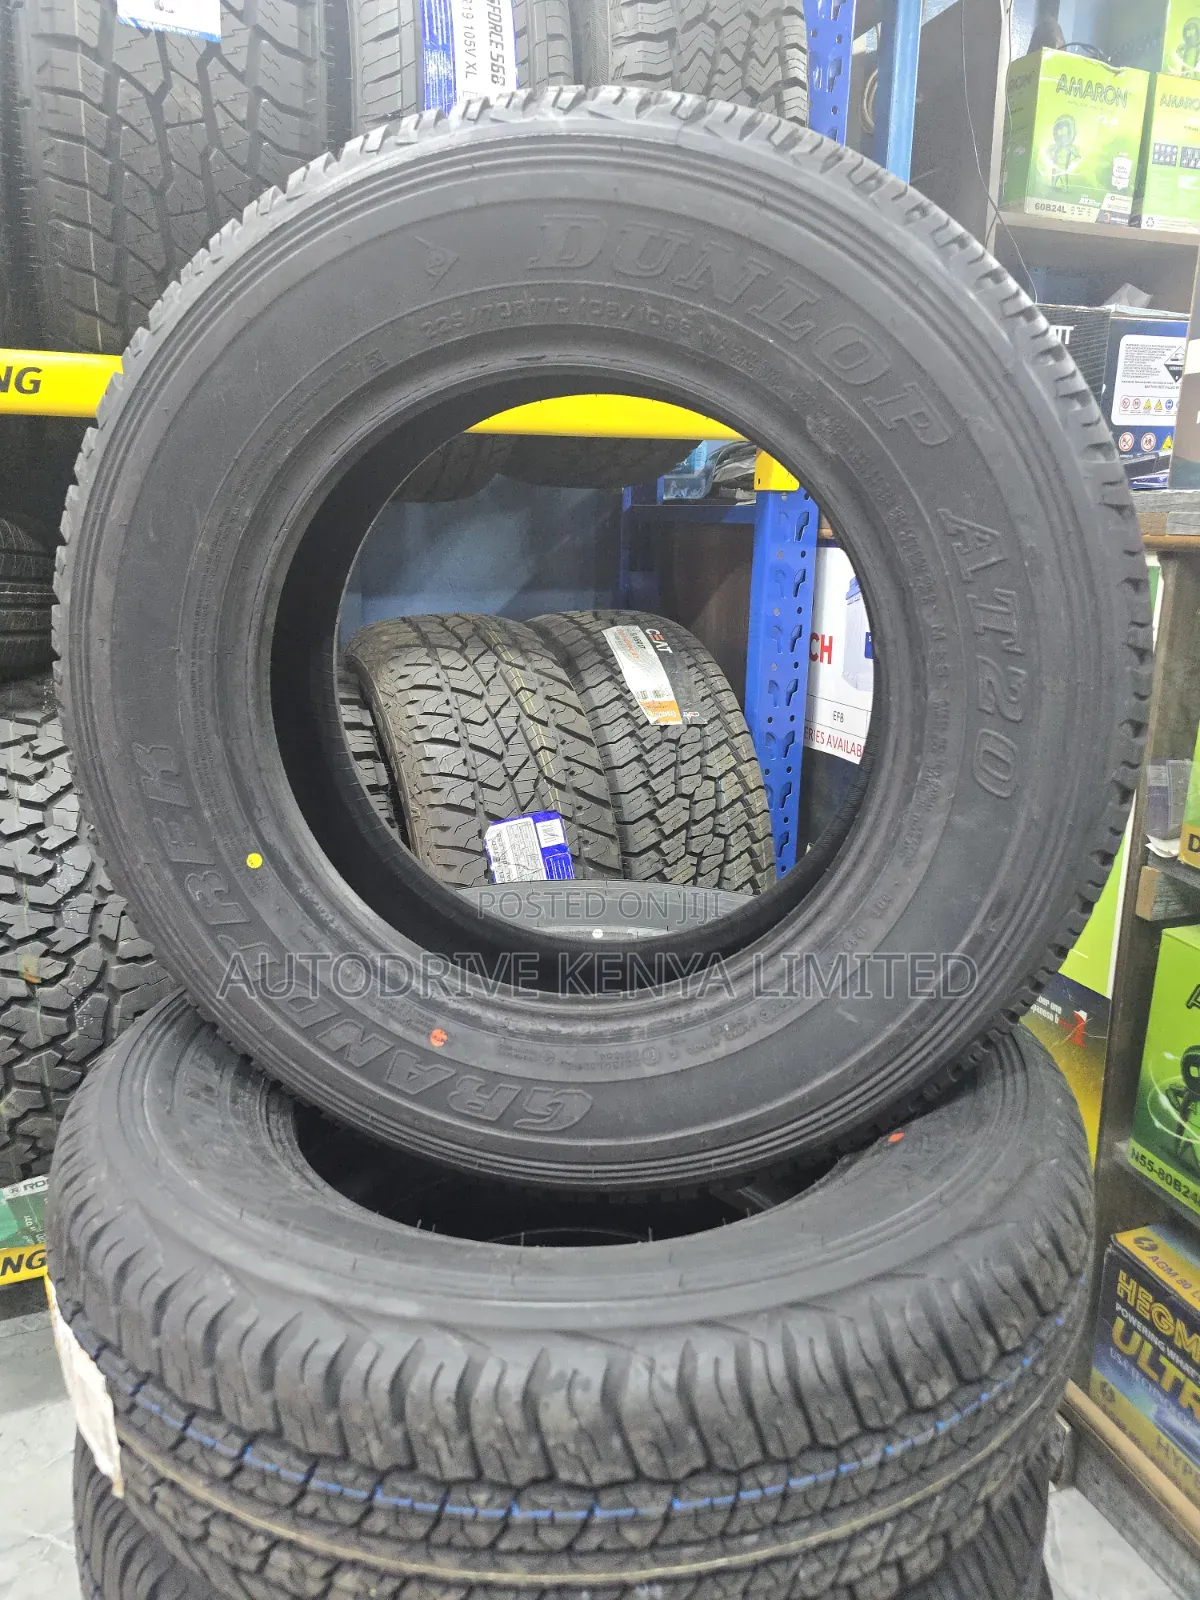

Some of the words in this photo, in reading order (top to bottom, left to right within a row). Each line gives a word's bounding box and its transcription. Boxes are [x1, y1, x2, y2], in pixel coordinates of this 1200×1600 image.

[464, 60, 478, 79] XL
[1056, 73, 1129, 108] AMARON
[1034, 202, 1067, 214] 60B24L
[522, 213, 953, 446] DUNLOP
[645, 628, 673, 655] CEAT
[938, 507, 1026, 801] AT20
[832, 710, 845, 723] EFB
[826, 733, 864, 759] AVAILAB
[135, 742, 594, 1132] GRANDTREK
[1147, 1255, 1179, 1278] AGM
[1116, 1302, 1166, 1352] POWERING
[1109, 1347, 1129, 1371] USA
